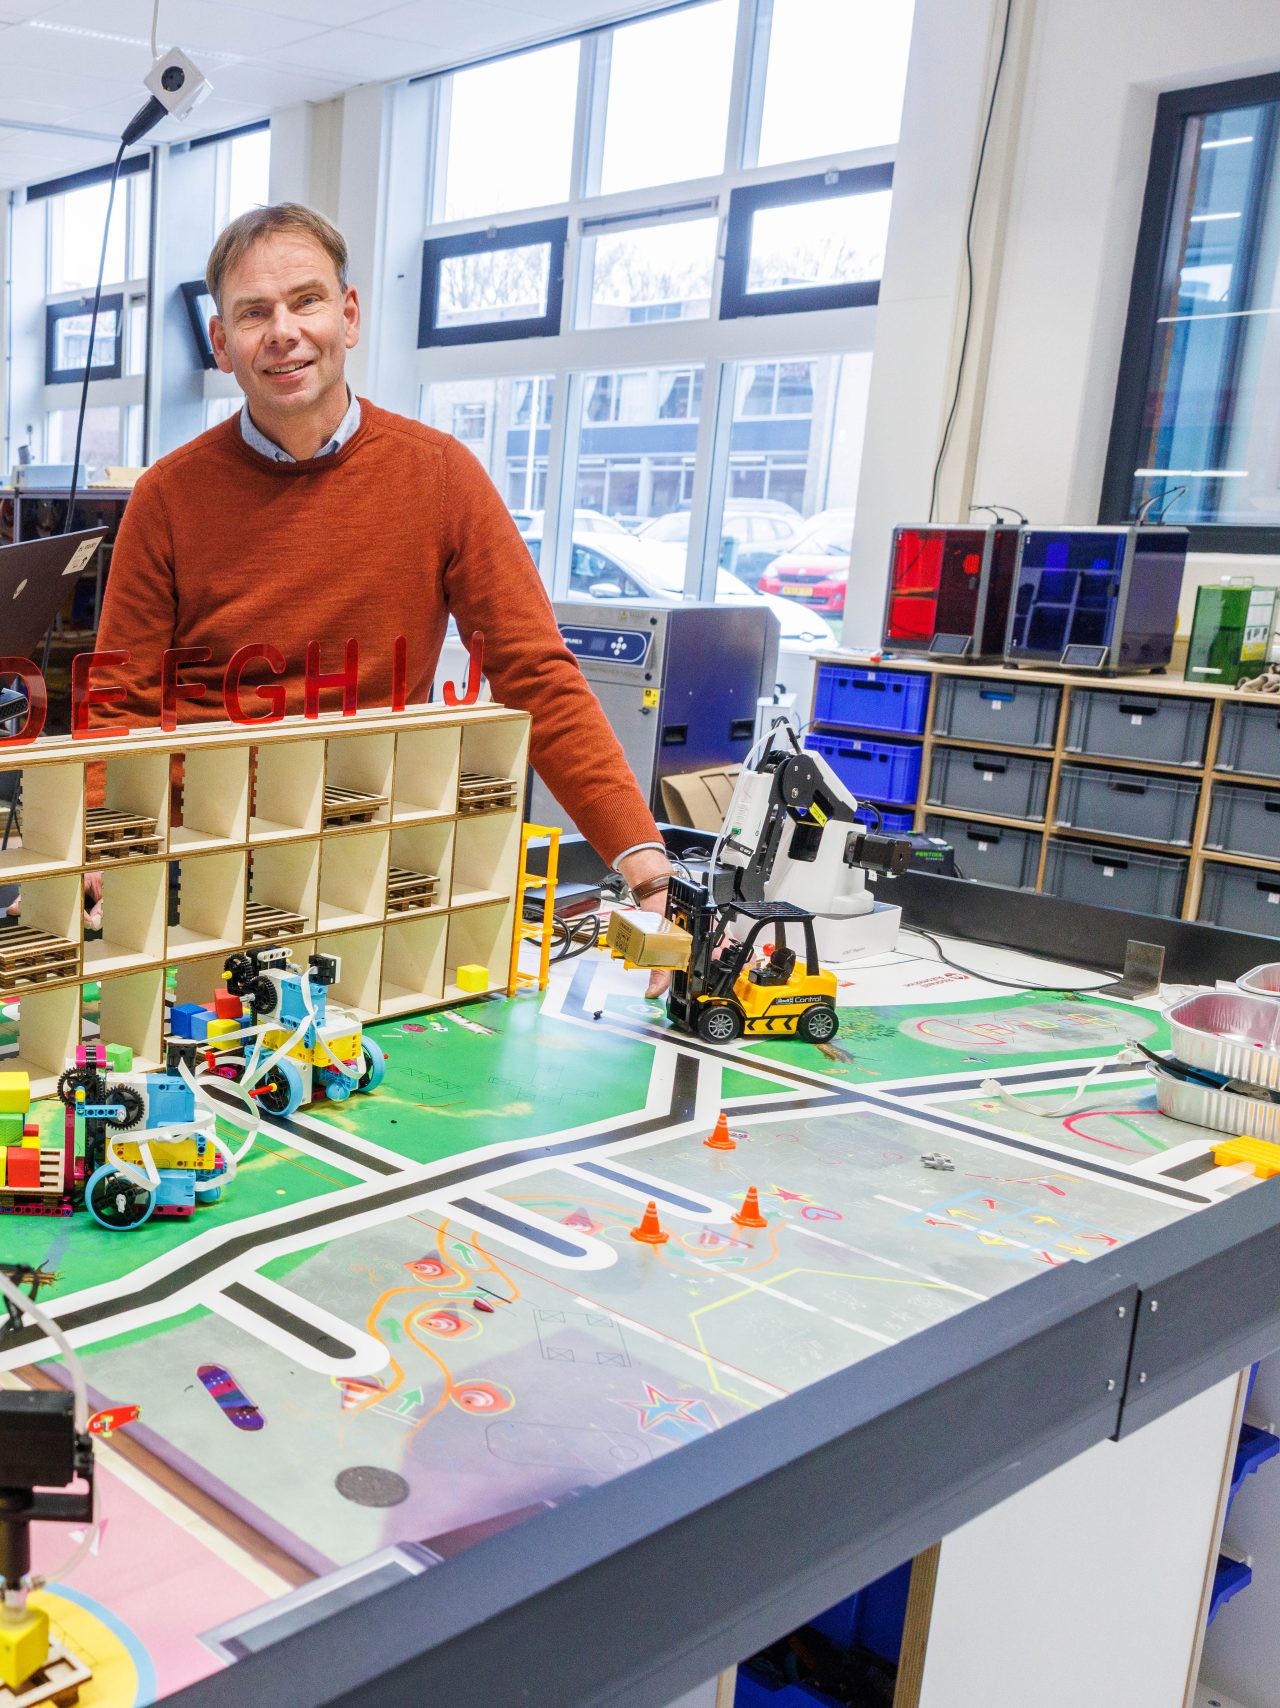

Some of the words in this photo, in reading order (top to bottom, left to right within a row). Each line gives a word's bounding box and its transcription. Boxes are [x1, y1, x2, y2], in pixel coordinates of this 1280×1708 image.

[71, 649, 131, 740] E
[160, 645, 213, 733] F
[223, 642, 288, 726] G
[305, 637, 359, 720] H
[392, 634, 406, 712] I
[442, 630, 485, 708] J
